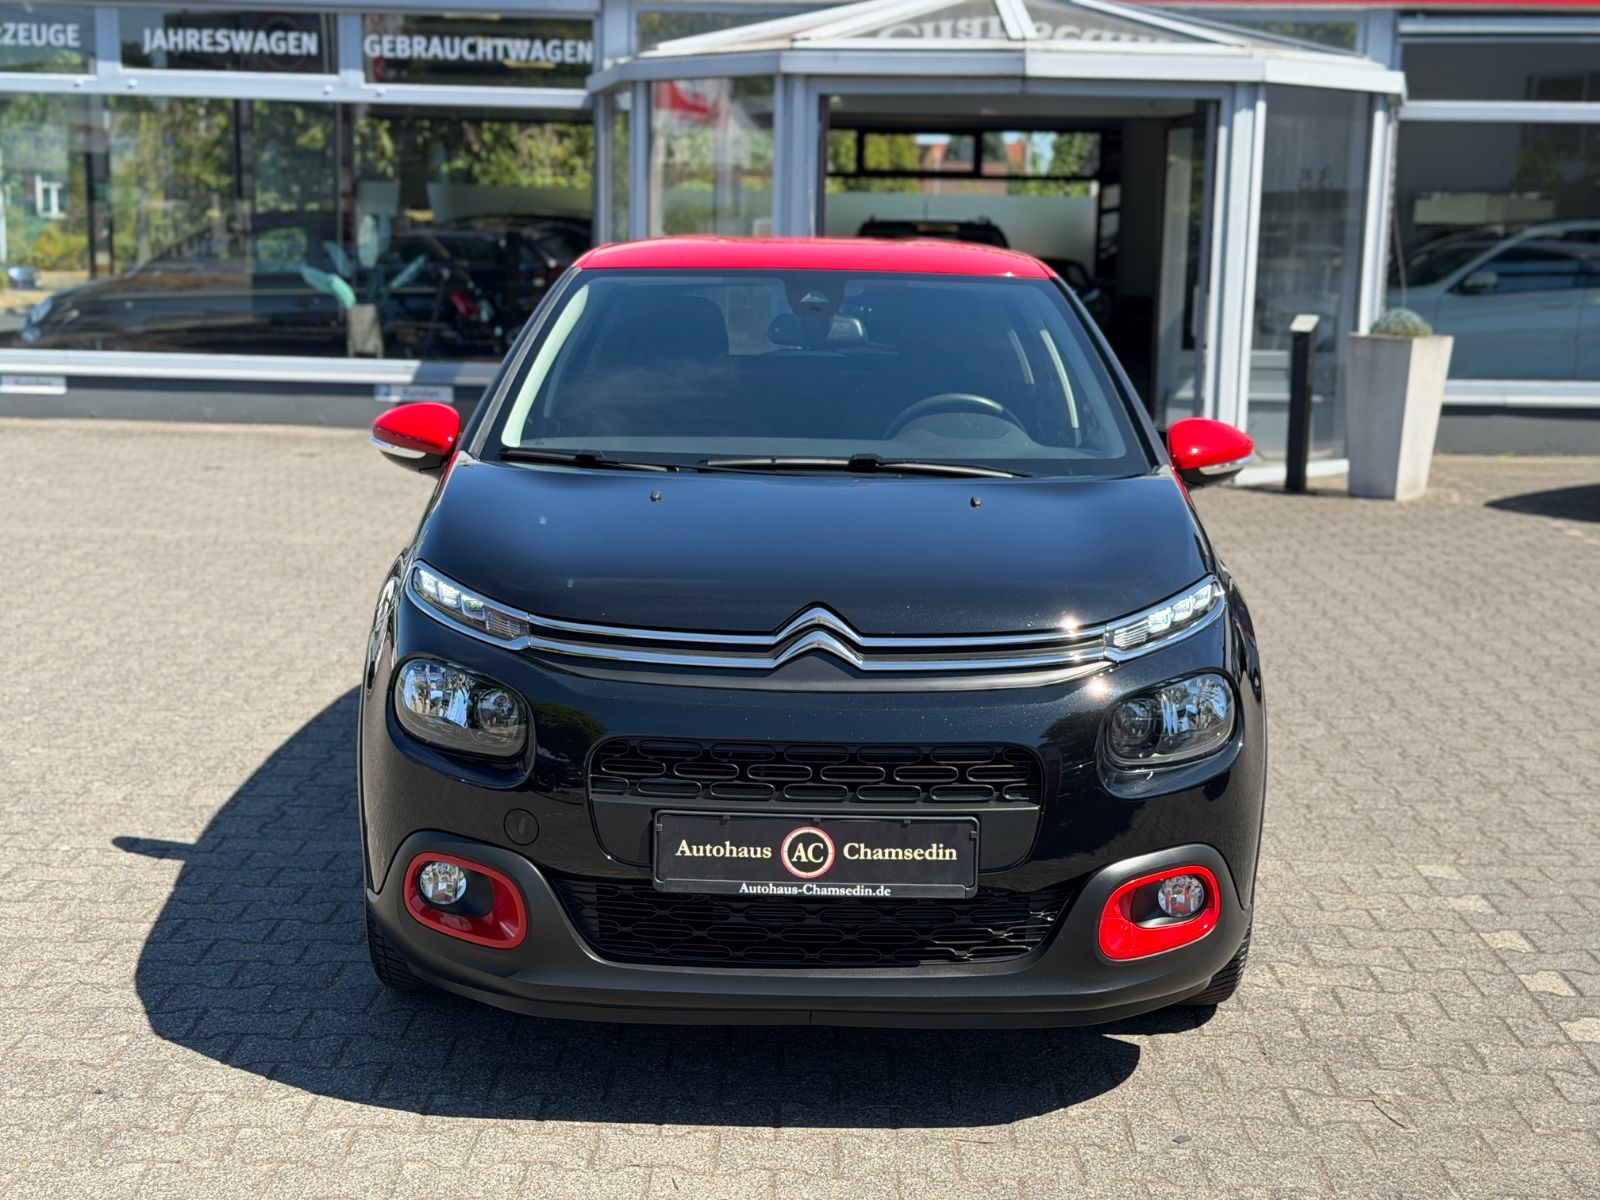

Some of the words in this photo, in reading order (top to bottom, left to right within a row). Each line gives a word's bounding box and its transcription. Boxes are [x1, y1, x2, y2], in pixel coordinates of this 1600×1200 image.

[0, 22, 80, 47] ZEUGE
[143, 27, 318, 56] JAHRESWAGEN
[363, 33, 593, 64] GEBRAUCHTWAGEN
[675, 839, 772, 859] Autohaus
[791, 842, 825, 864] AC
[842, 842, 958, 862] Chamsedin
[738, 882, 891, 897] Autohaus-Chamsedin.de
